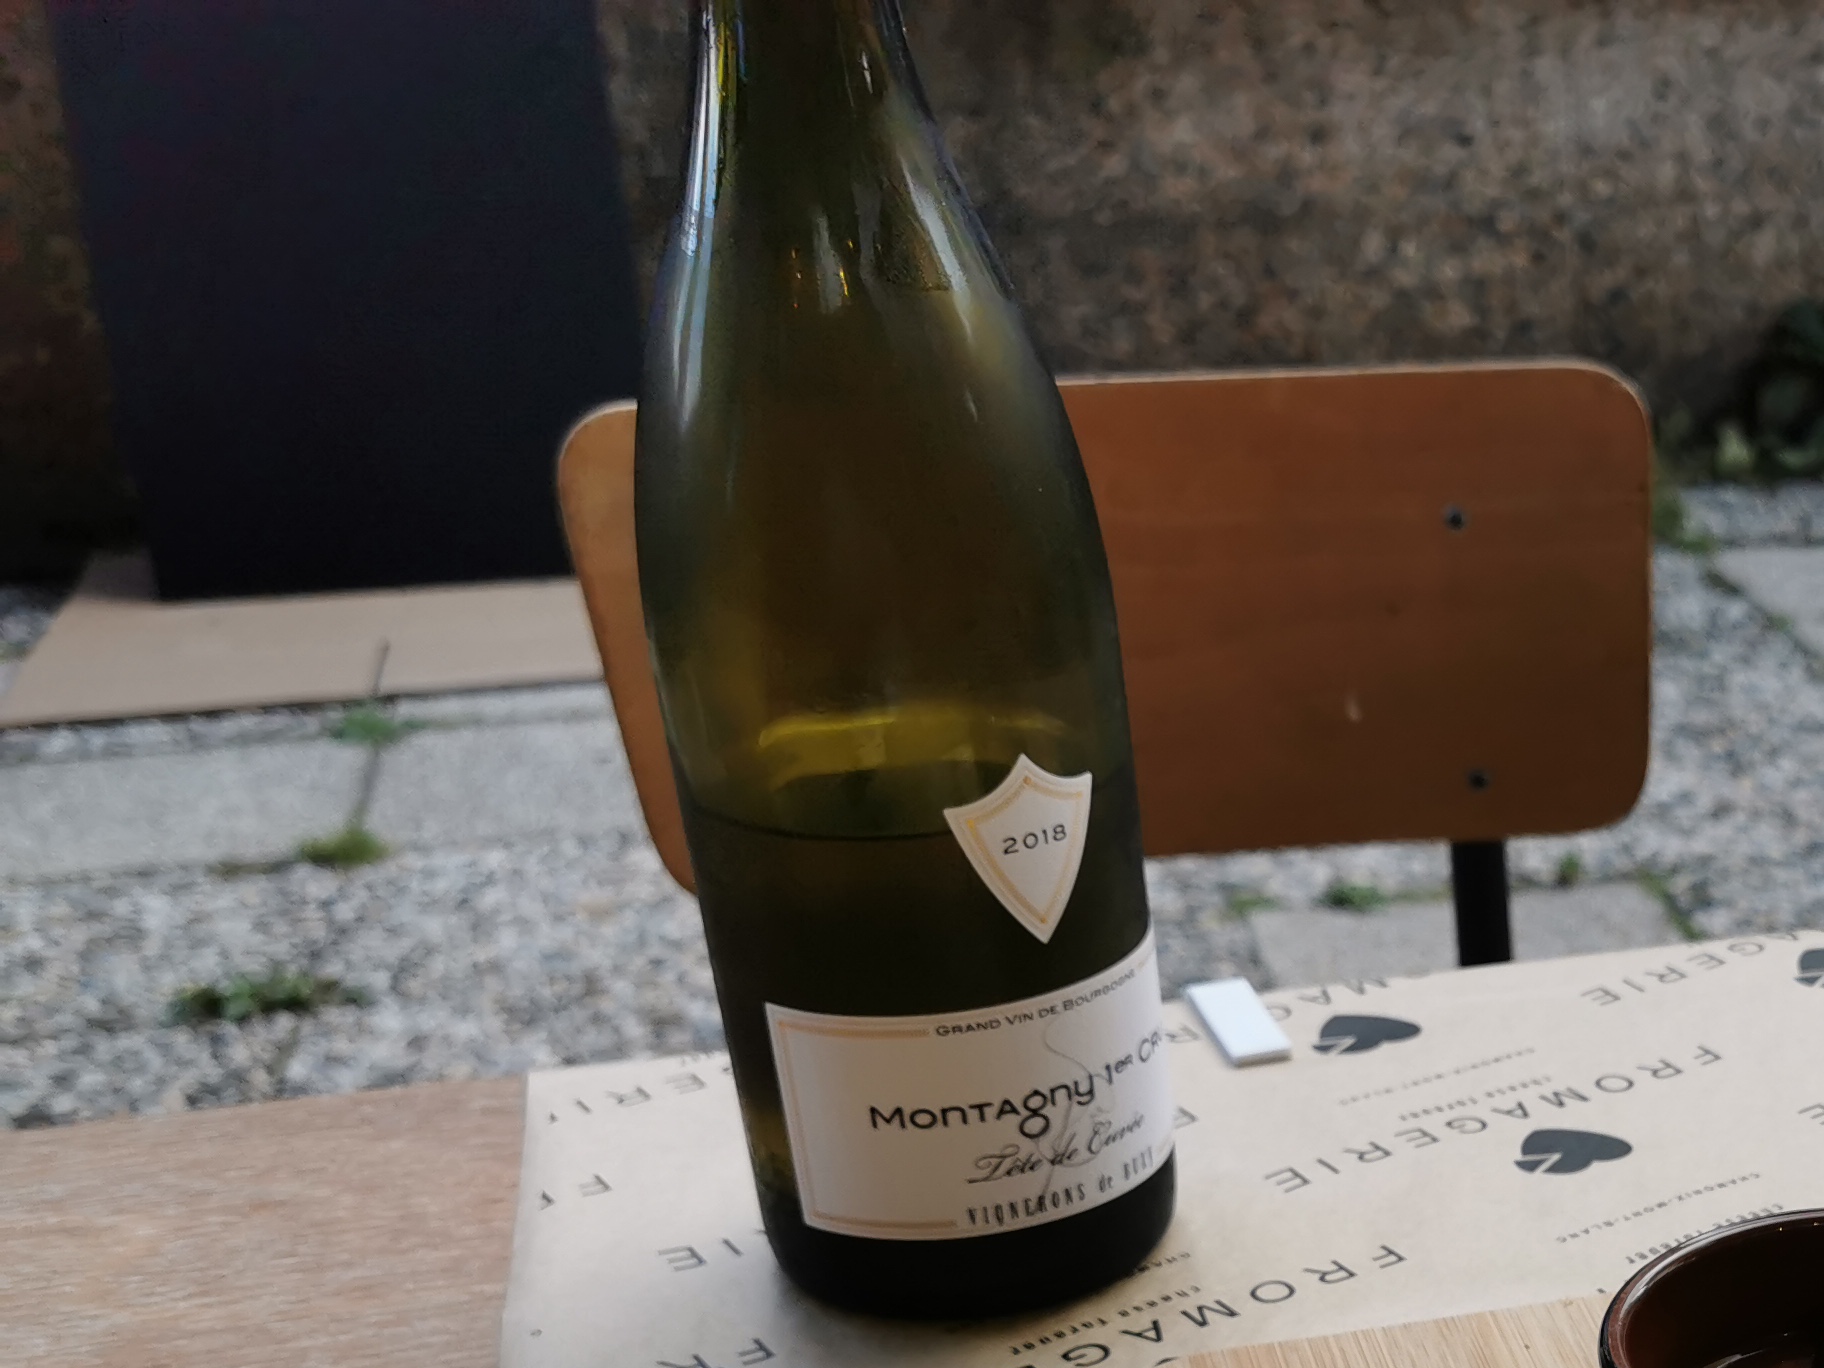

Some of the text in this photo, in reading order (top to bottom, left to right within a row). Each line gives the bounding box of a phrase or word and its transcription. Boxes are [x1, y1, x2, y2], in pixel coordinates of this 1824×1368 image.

[1002, 823, 1067, 855] 2018
[935, 1018, 1001, 1037] GRAND
[1005, 1012, 1034, 1025] VIN
[1038, 1005, 1058, 1019] DE
[1265, 1045, 1722, 1194] FROMAGERIE
